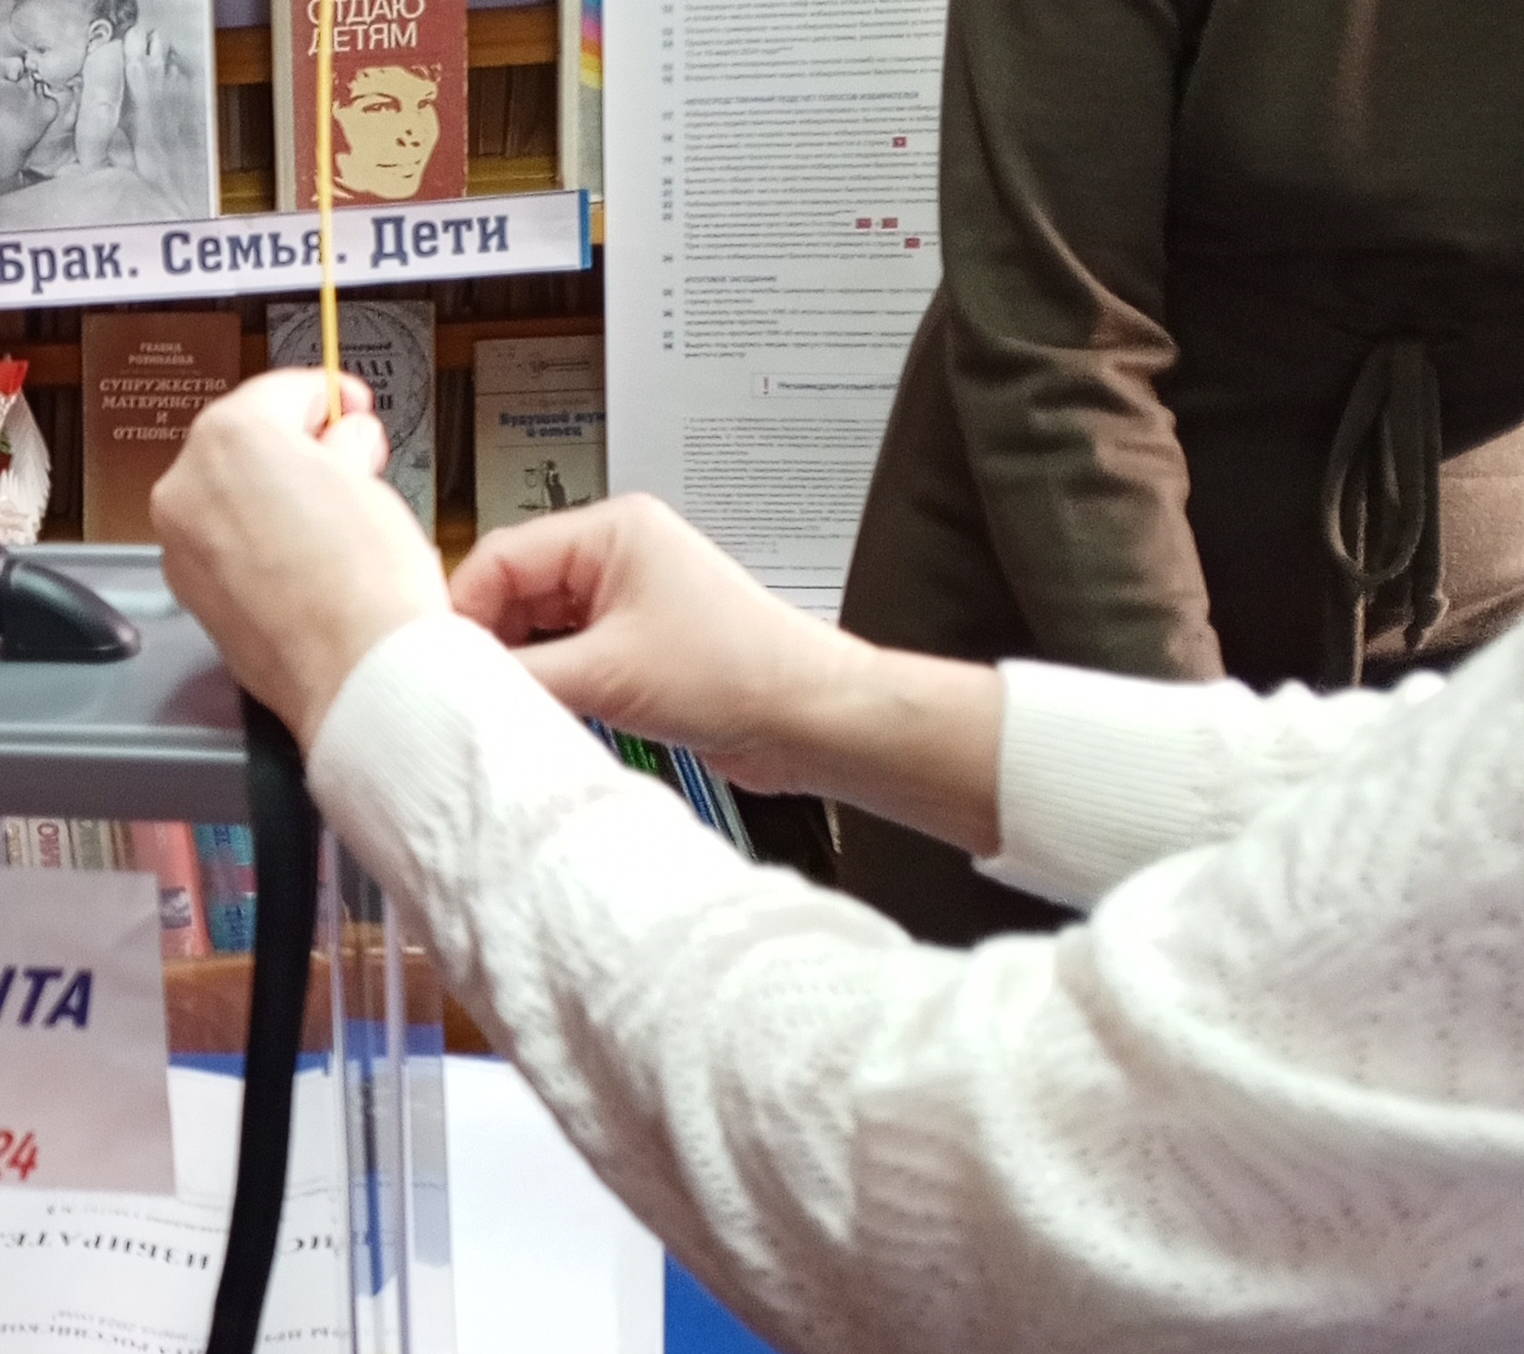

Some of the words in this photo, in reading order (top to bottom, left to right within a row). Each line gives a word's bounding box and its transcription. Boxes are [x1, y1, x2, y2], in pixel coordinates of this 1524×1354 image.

[161, 229, 346, 276] Семья.
[370, 214, 510, 269] Дети
[156, 410, 168, 425] И
